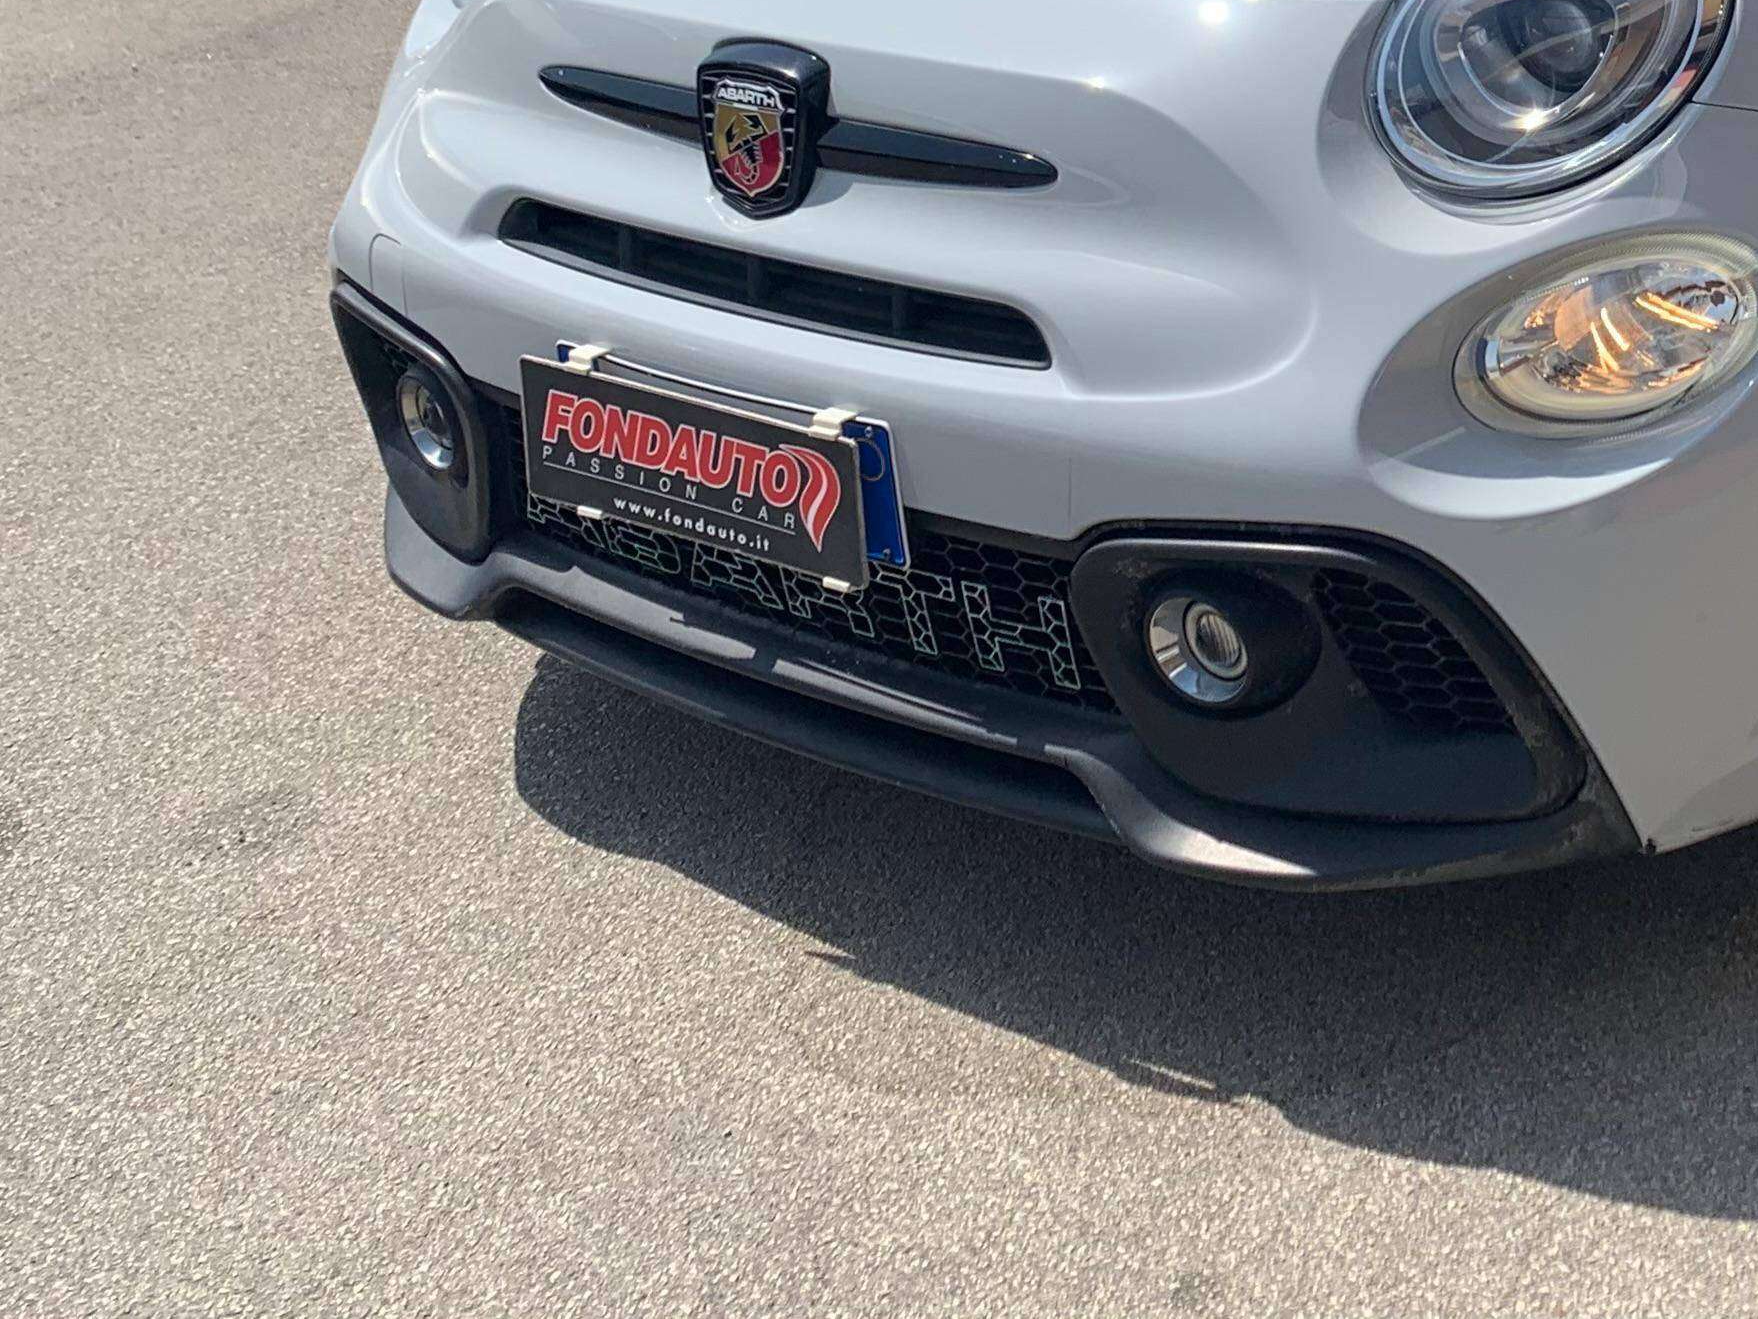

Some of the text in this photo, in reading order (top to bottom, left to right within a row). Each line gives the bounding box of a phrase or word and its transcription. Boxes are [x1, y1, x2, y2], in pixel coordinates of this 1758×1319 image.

[717, 86, 776, 109] ABARTH
[541, 388, 801, 509] FONDAUTO
[541, 444, 796, 530] PASSION CAR
[612, 496, 770, 552] www.fondauto.it
